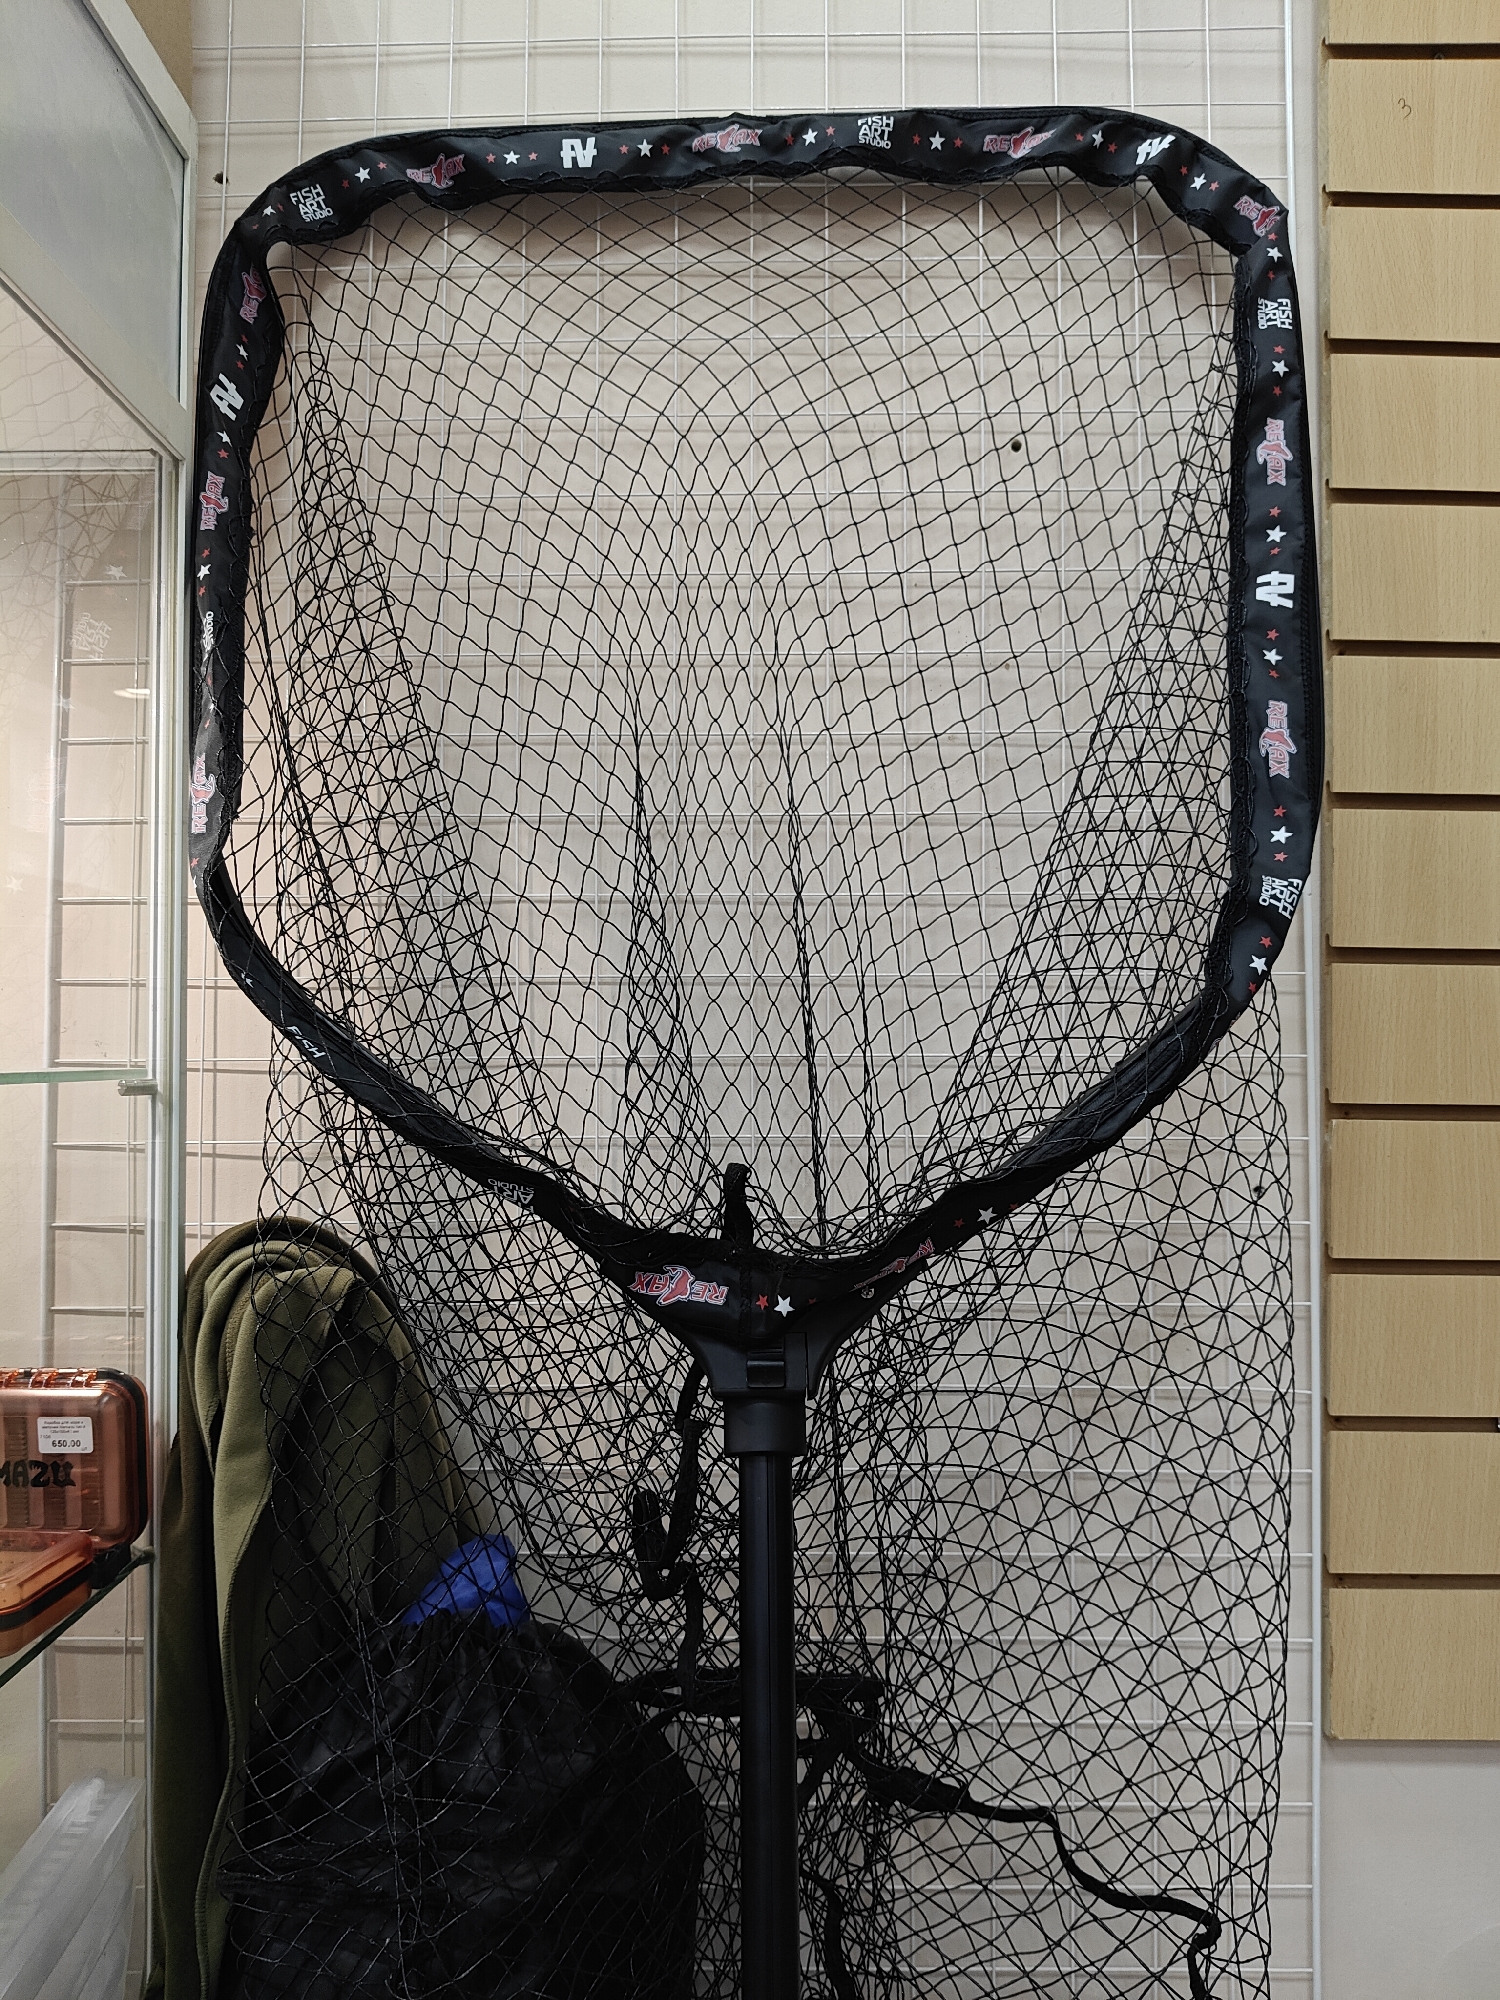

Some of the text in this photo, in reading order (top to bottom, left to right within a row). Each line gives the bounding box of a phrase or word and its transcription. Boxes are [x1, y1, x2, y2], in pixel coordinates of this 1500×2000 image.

[857, 115, 894, 129] FISH
[858, 124, 893, 141] ART
[858, 135, 892, 150] STUDIO
[289, 183, 325, 206] FISH
[298, 195, 327, 216] ART
[302, 207, 334, 223] STUDIO
[1257, 296, 1268, 330] STUDIO
[1264, 299, 1281, 328] ART
[1277, 298, 1293, 330] FISH
[1259, 699, 1297, 779] RELAX
[1258, 874, 1272, 907] STUDIO
[1270, 877, 1289, 914] ART
[1287, 878, 1303, 920] FISH
[51, 1439, 82, 1448] 650.00
